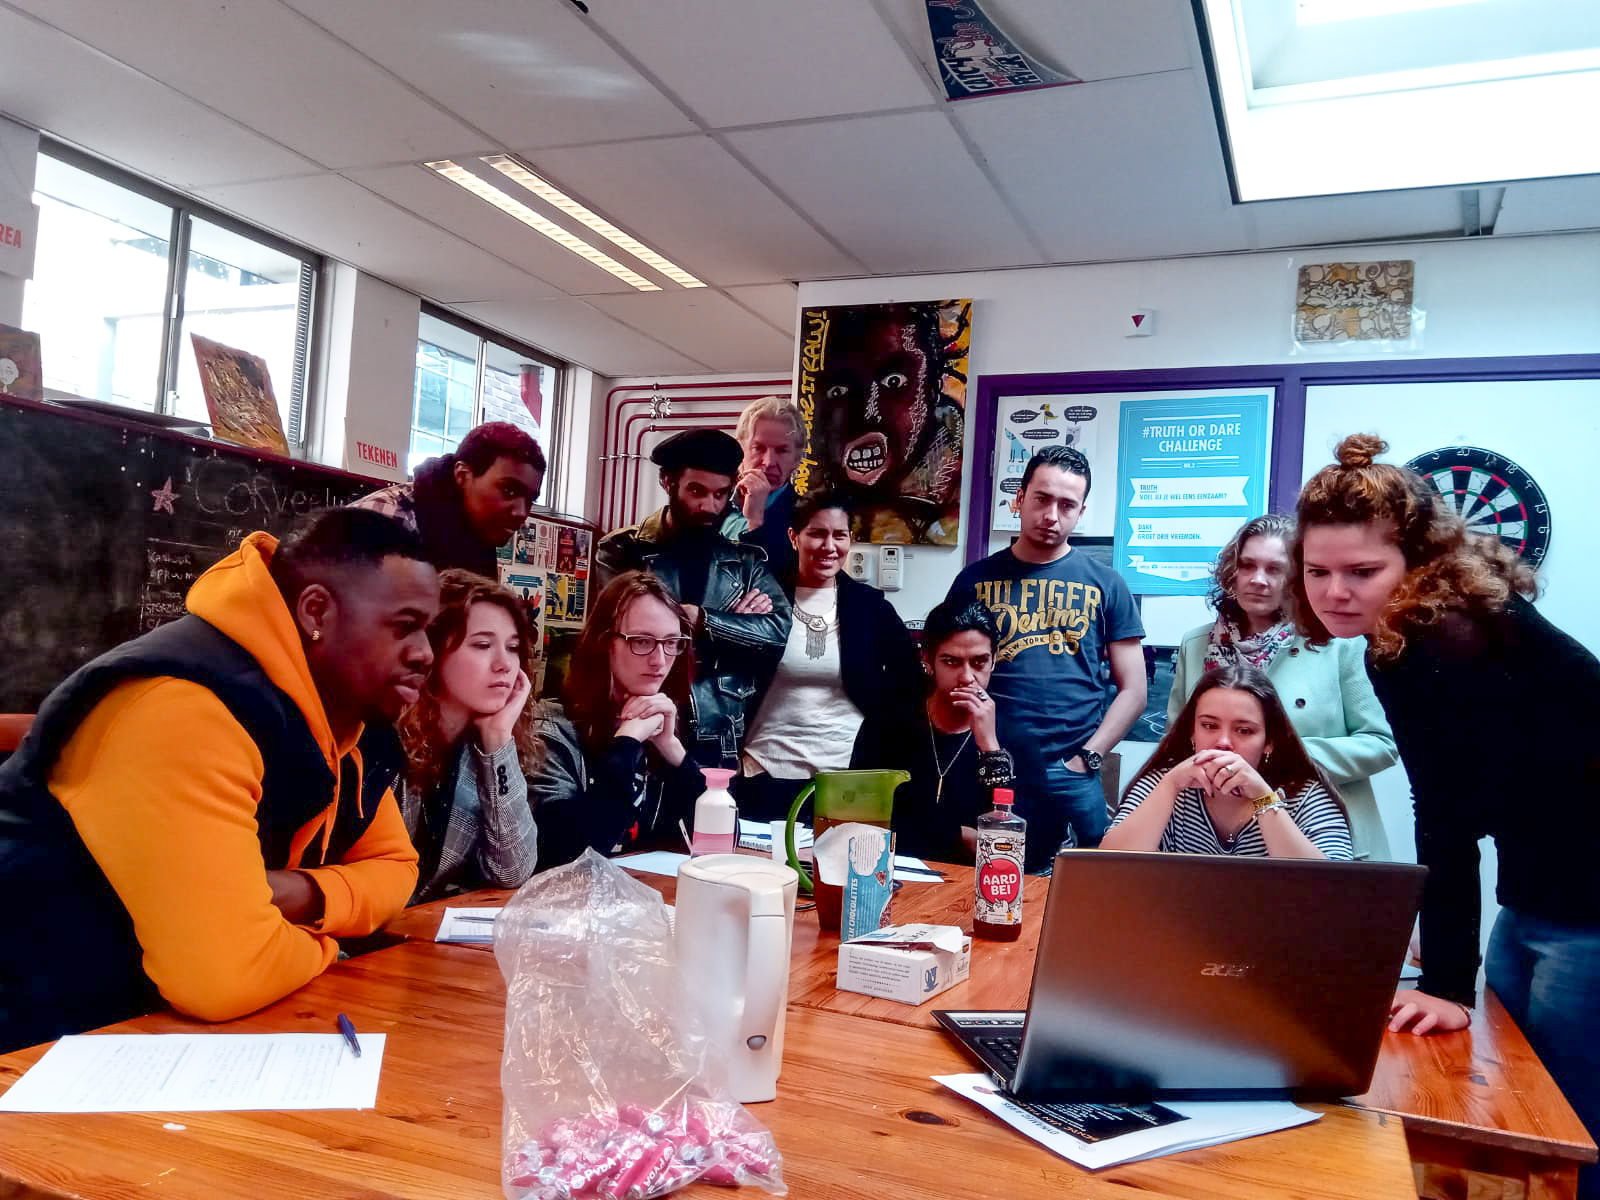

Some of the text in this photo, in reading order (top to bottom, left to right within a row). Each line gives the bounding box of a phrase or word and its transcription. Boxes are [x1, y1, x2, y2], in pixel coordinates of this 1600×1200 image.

[1142, 422, 1241, 438] #TRUTH OR DARE
[356, 441, 398, 468] TEKENEN
[1158, 438, 1223, 453] CHALLENGE
[1182, 492, 1196, 500] EENS
[975, 579, 1101, 621] HILFIGER
[990, 601, 1087, 645] Denim
[1002, 637, 1045, 659] NEW YORK
[1048, 630, 1081, 656] 85
[982, 873, 1018, 886] AARD
[990, 884, 1011, 896] BEI
